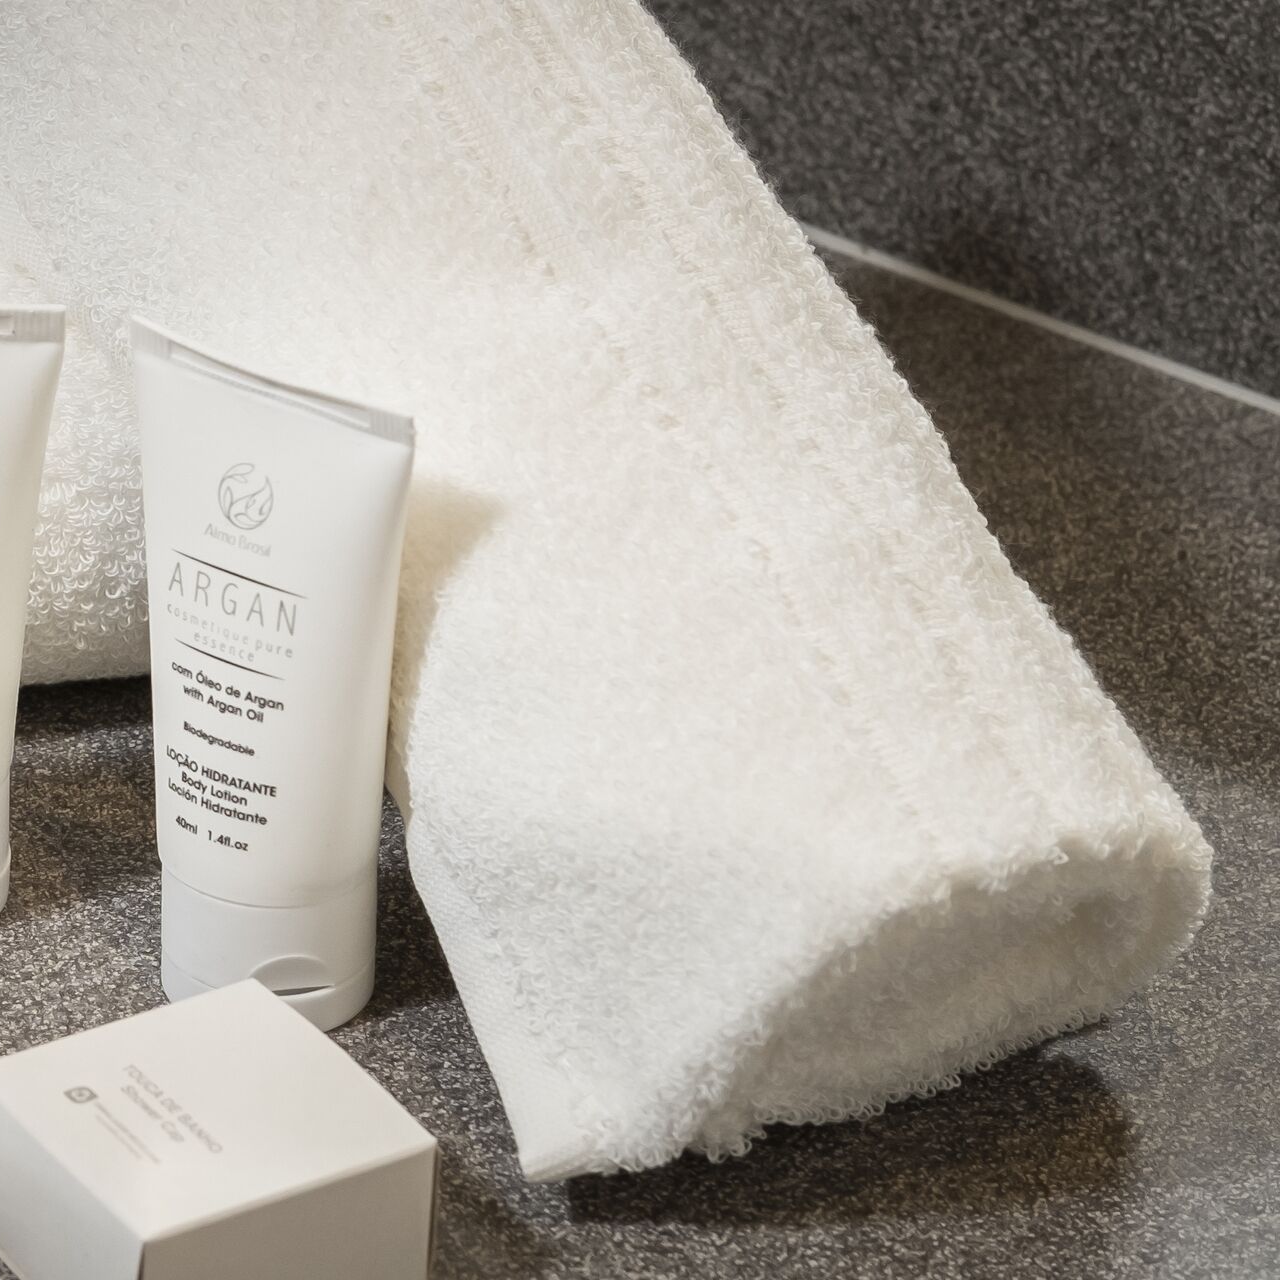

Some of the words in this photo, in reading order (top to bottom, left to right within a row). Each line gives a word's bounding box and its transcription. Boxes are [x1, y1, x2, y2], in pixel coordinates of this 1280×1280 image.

[168, 562, 296, 636] ARGAN
[193, 631, 255, 662] essence
[255, 638, 293, 658] pure
[172, 662, 193, 679] com
[196, 670, 222, 691] Óleo
[225, 686, 240, 698] de
[244, 691, 284, 711] Argan
[183, 685, 204, 701] with
[207, 695, 242, 716] Argan
[246, 709, 264, 723] Oil
[183, 720, 255, 756] Biodegradable
[166, 745, 198, 772] LOÇÃO
[201, 765, 276, 797] HIDRATANTE
[181, 771, 207, 794] Body
[211, 785, 247, 806] Lotion
[168, 777, 197, 804] Loción
[201, 797, 267, 825] Hidratante
[176, 816, 198, 834] 40ml
